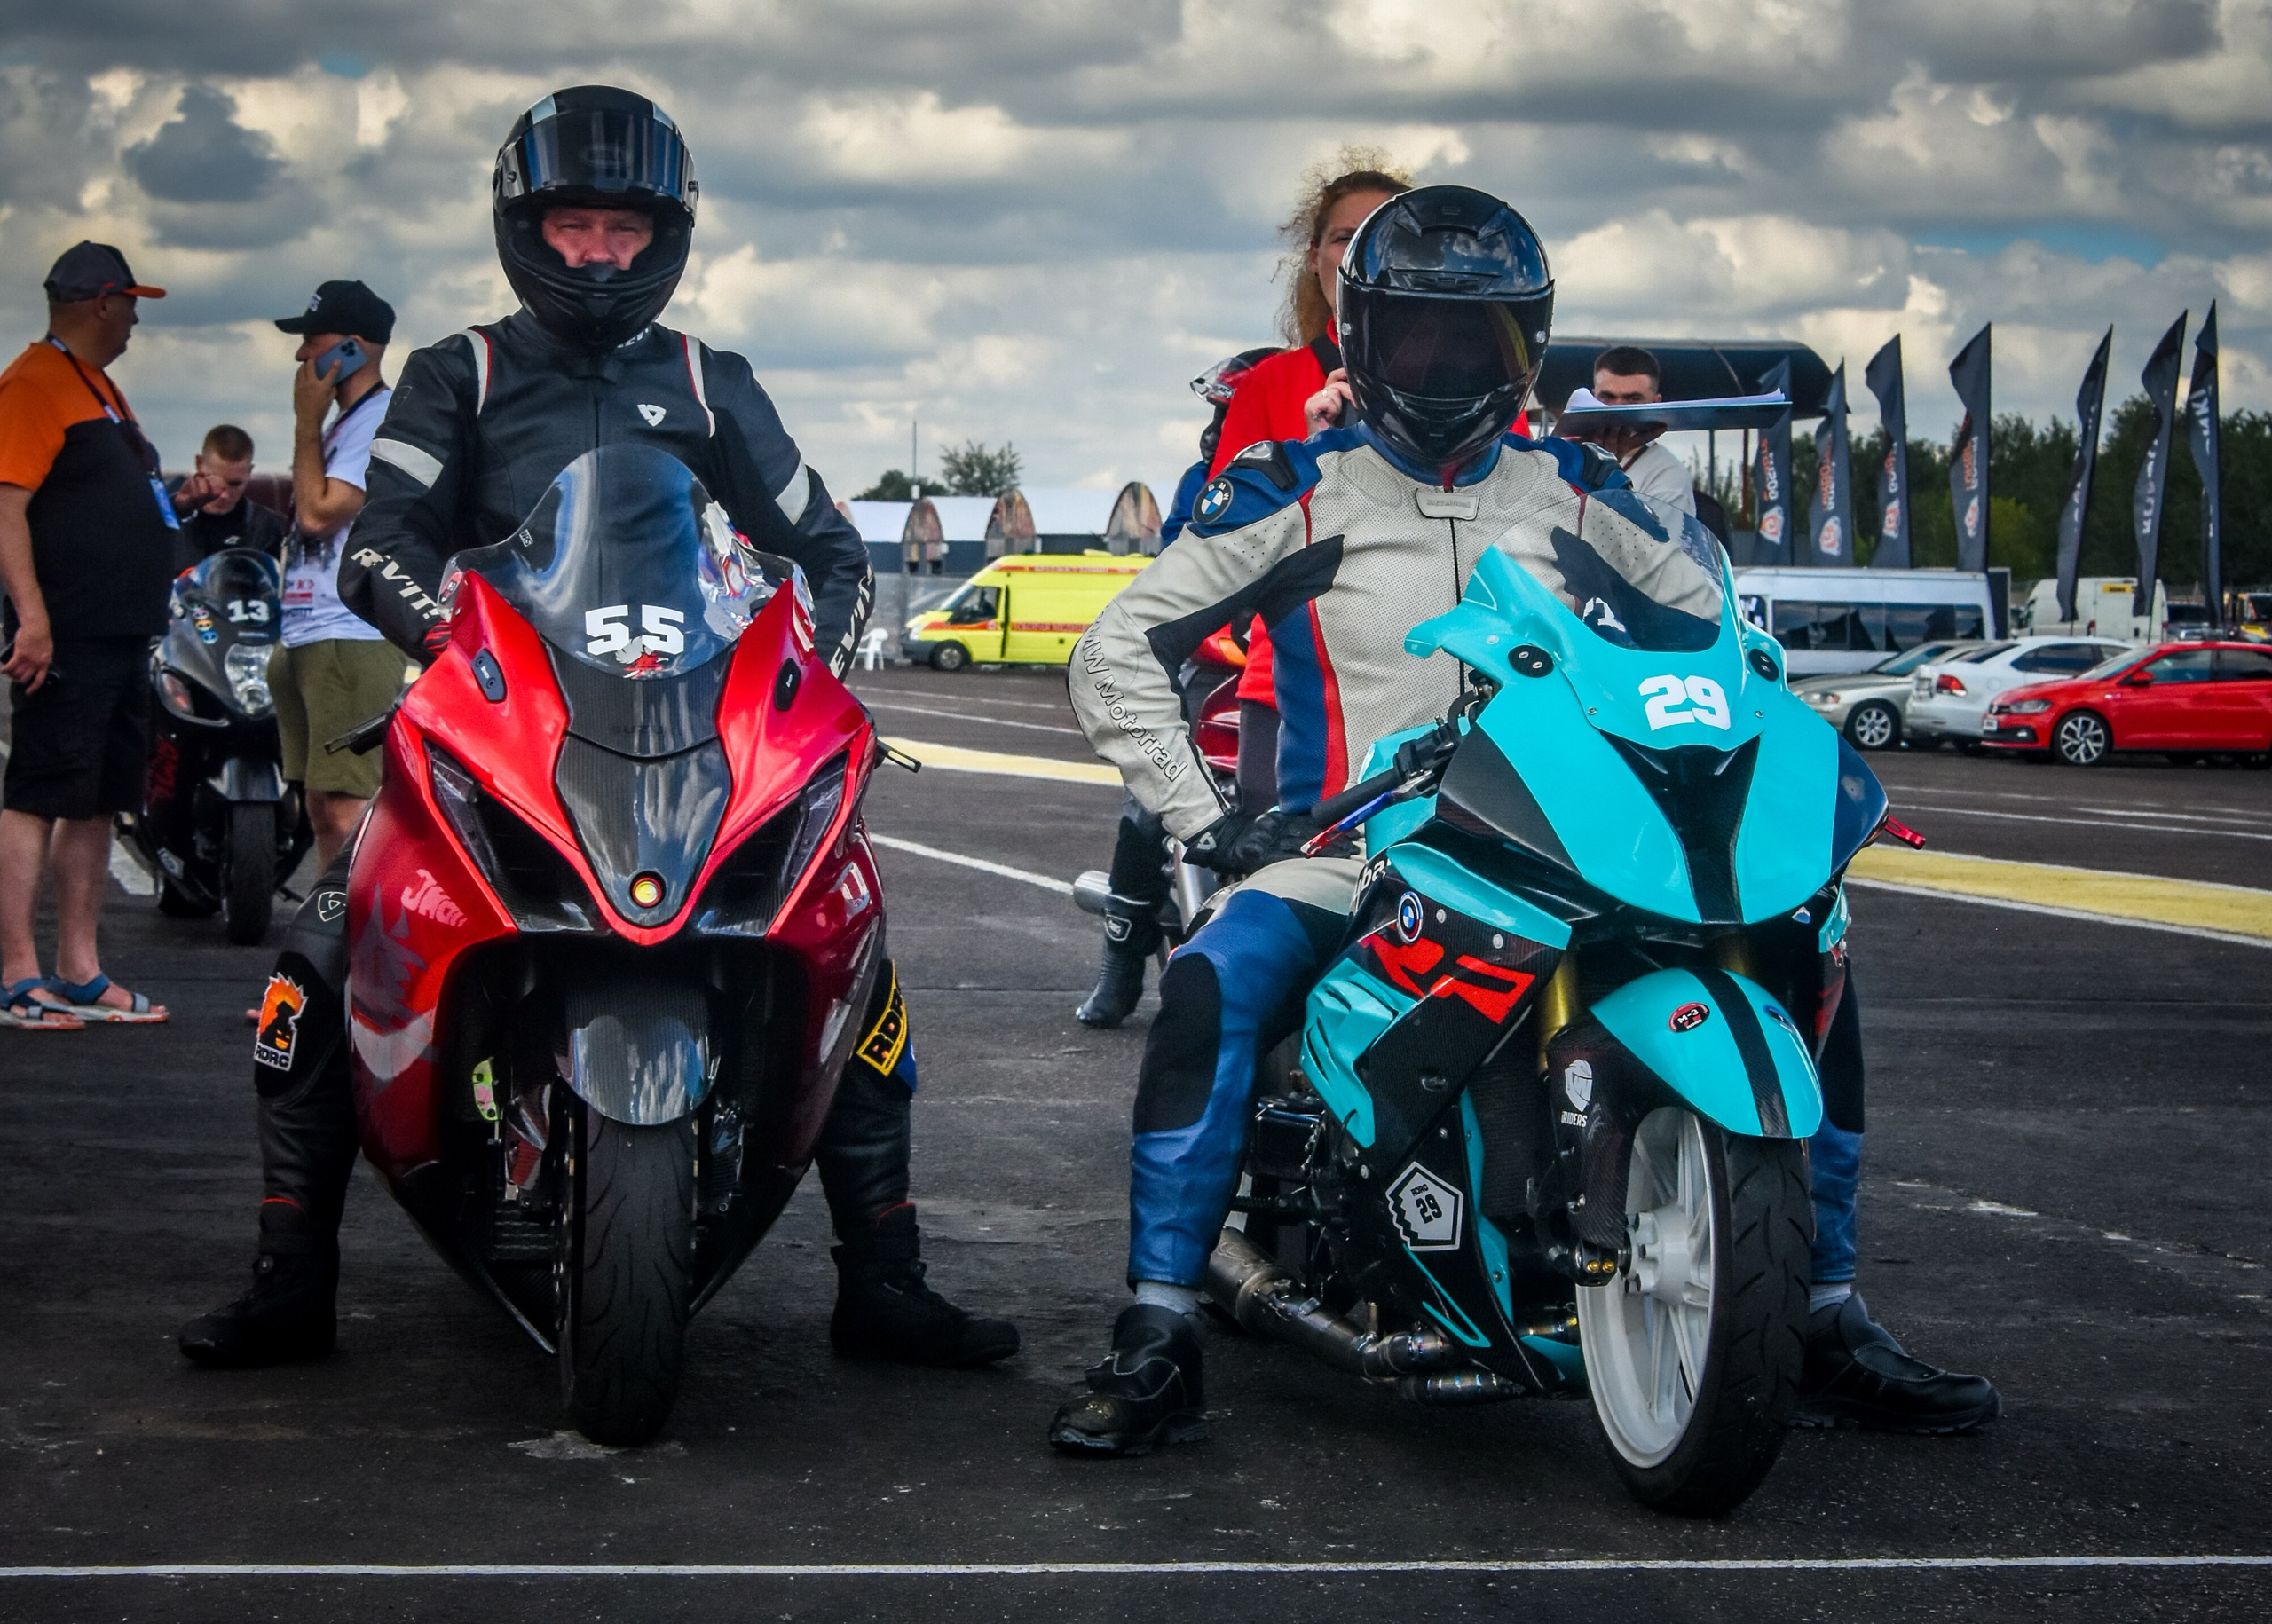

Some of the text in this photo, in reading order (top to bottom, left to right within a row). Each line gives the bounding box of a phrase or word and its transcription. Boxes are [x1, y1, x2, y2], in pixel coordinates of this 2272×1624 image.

[1208, 482, 1230, 501] BMW
[227, 599, 270, 623] 13
[584, 604, 684, 656] 55
[1638, 674, 1731, 732] 29
[1094, 674, 1188, 783] Motorrad
[1677, 1009, 1699, 1024] M-3
[255, 1045, 289, 1068] RDRC
[1416, 1194, 1443, 1224] 29
